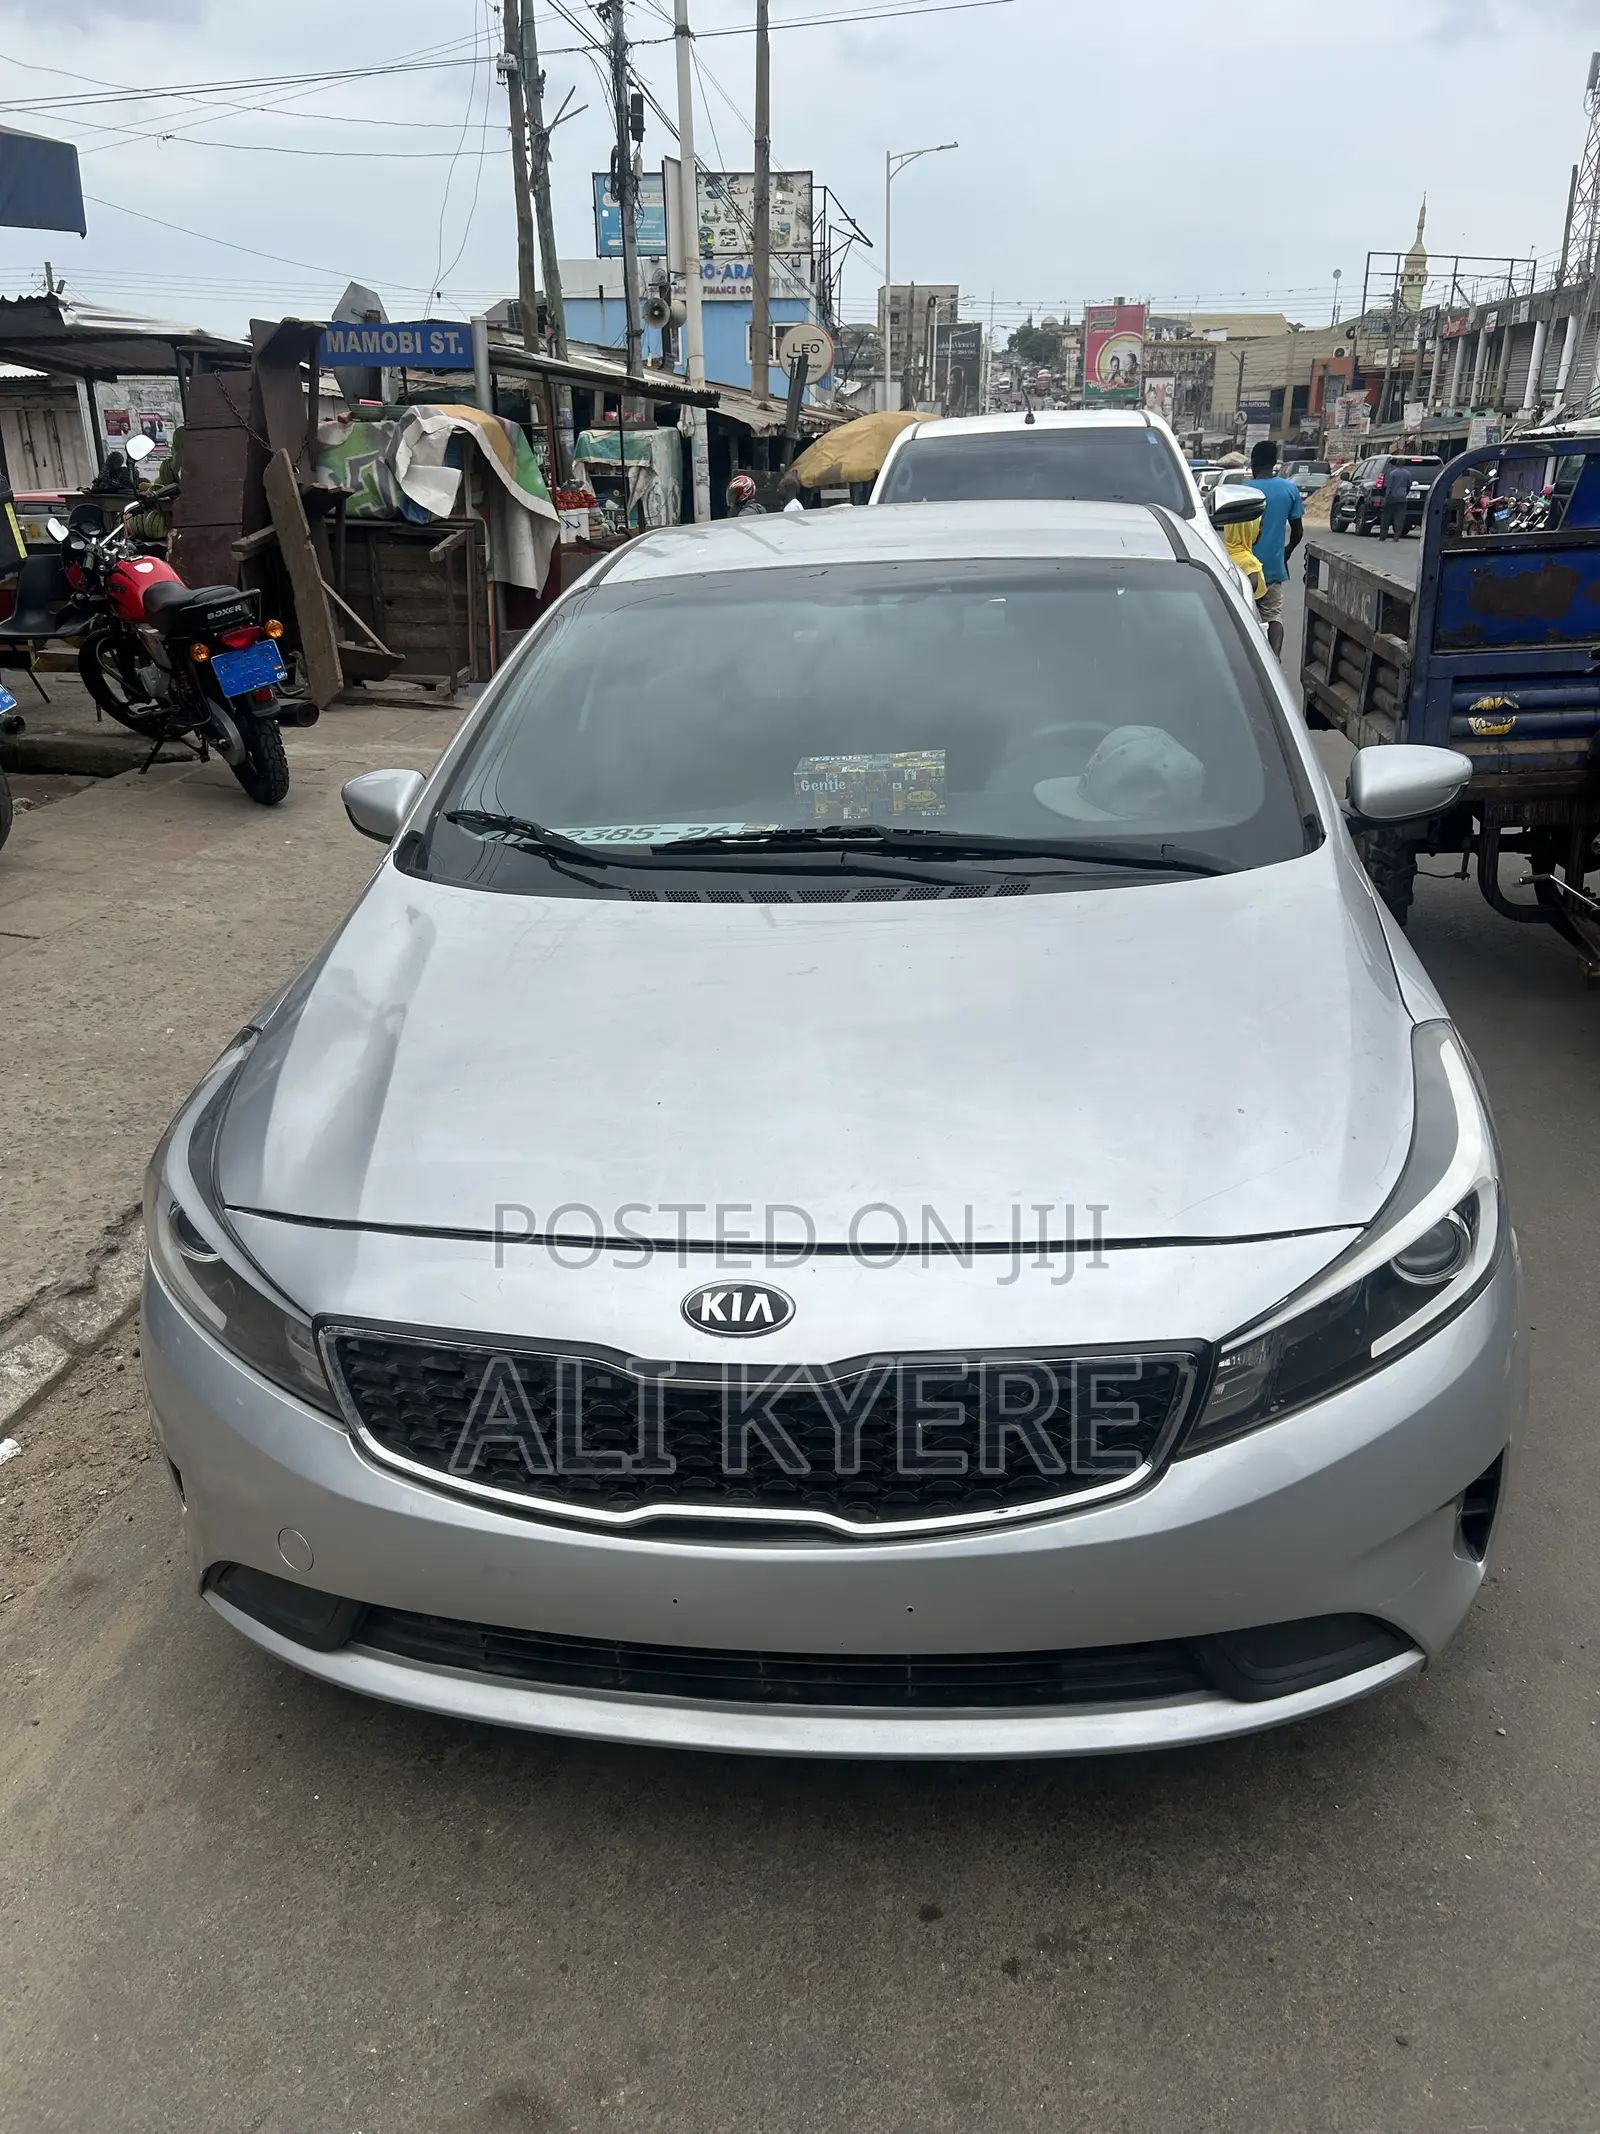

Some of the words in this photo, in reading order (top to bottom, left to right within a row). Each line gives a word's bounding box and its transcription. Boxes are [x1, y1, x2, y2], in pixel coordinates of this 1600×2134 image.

[703, 286, 737, 295] FINANCE
[326, 330, 423, 354] MAMOBI
[430, 332, 464, 354] ST.
[792, 343, 821, 354] LEO
[207, 604, 242, 620] BOXER
[800, 778, 847, 792] Gentle
[566, 824, 731, 842] 2385-26
[700, 1291, 774, 1323] KIA
